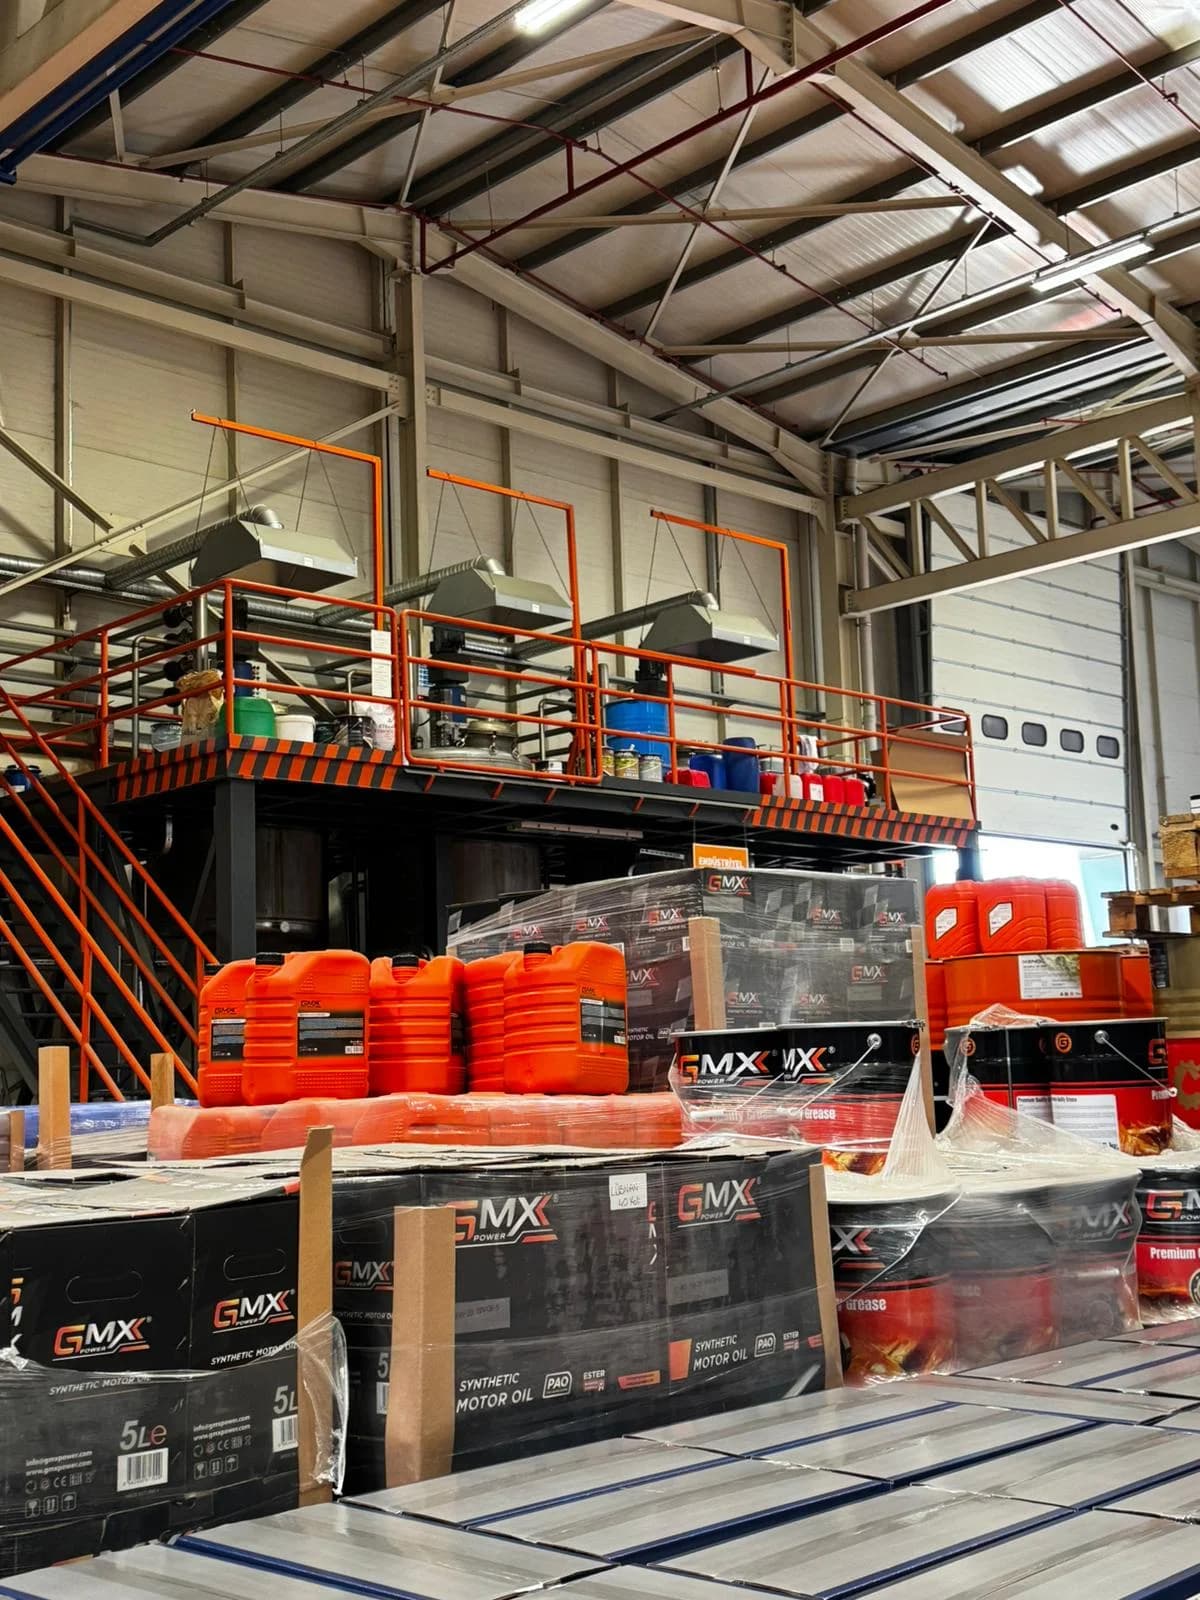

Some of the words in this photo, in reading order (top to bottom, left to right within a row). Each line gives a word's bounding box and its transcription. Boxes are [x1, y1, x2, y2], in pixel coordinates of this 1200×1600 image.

[708, 875, 749, 893] GMX
[575, 916, 608, 932] GMX
[648, 907, 684, 927] GMX
[877, 911, 905, 925] GMX
[851, 965, 886, 980] GMX
[680, 1051, 768, 1084] GMX
[804, 1107, 836, 1121] Grease
[678, 1178, 755, 1221] GMX
[448, 1194, 552, 1240] GMX
[701, 1211, 724, 1220] POWER
[473, 1231, 506, 1242] POWER
[1150, 1247, 1196, 1260] Premium
[335, 1261, 390, 1285] GMX
[213, 1289, 290, 1329] GMX
[846, 1298, 887, 1311] Grease
[54, 1318, 146, 1356] GMX
[695, 1334, 738, 1353] SYNTHETIC
[757, 1335, 773, 1349] PAO
[783, 1330, 799, 1341] ESTER
[79, 1346, 108, 1354] POWER
[210, 1349, 254, 1366] SYNTHETIC
[693, 1351, 730, 1372] MOTOR
[732, 1347, 748, 1361] OIL
[459, 1372, 520, 1393] SYNTHETIC
[546, 1376, 569, 1390] PAO
[583, 1369, 606, 1381] ESTER
[49, 1380, 99, 1396] SYNTHETIC
[102, 1376, 134, 1388] MOTOR
[456, 1392, 507, 1414] MOTOR
[511, 1387, 534, 1403] OIL
